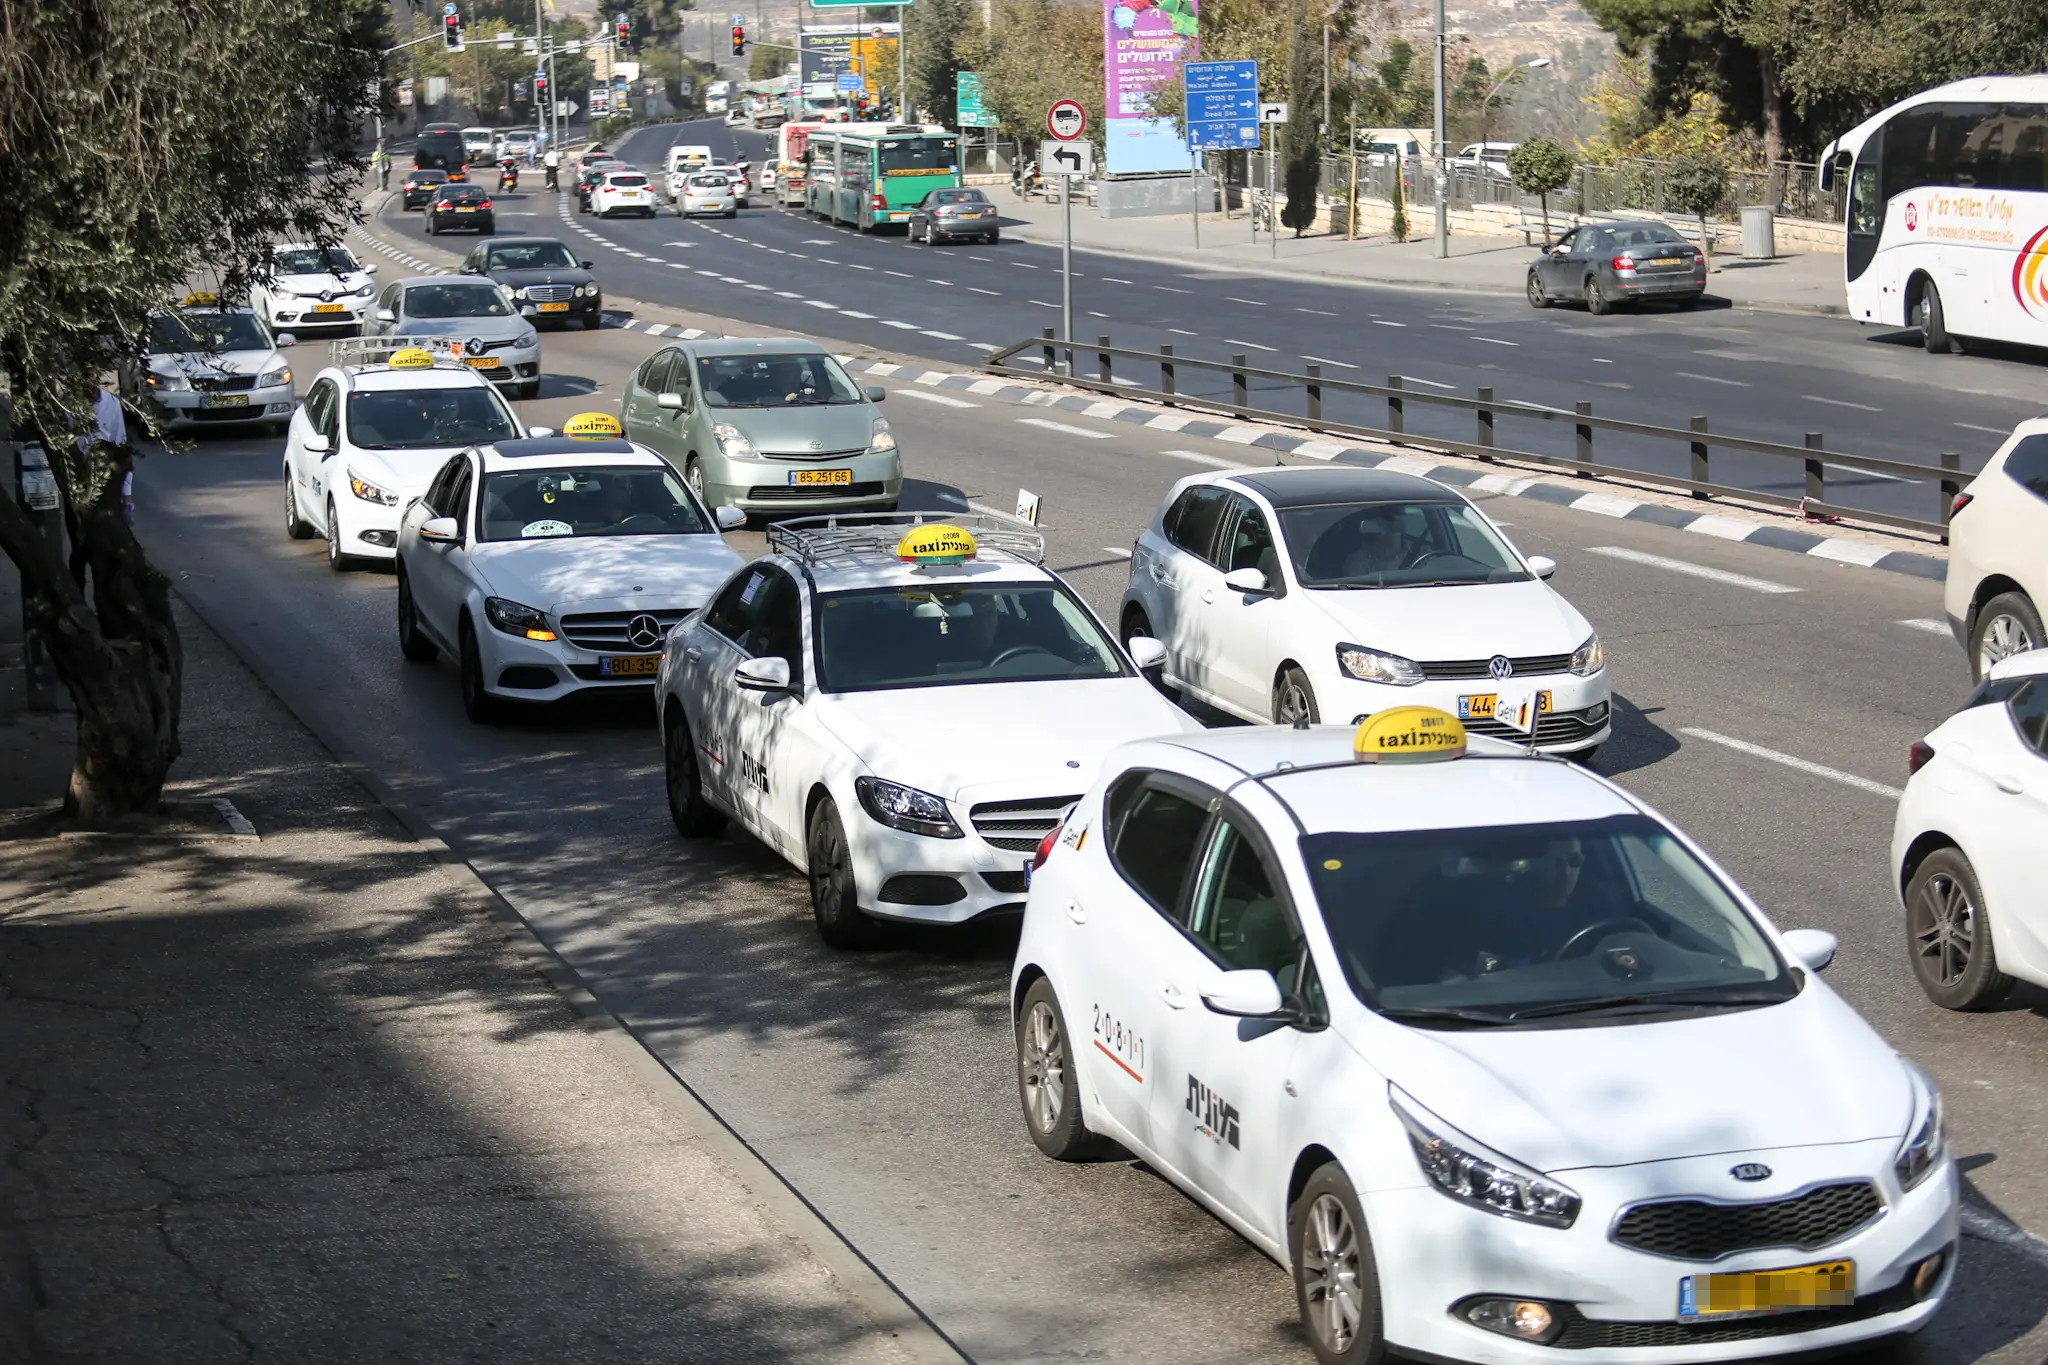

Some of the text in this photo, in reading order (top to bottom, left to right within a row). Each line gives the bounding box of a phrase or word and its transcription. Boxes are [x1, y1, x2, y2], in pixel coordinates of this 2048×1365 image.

[1117, 50, 1174, 63] בירושלים
[572, 420, 616, 431] taxi מונית
[913, 539, 970, 553] taxi מונית
[1497, 700, 1517, 723] Gett
[1378, 728, 1458, 747] taxi מונית
[1063, 827, 1079, 849] Gett
[1186, 1073, 1241, 1151] מונית
[1734, 1164, 1769, 1179] KIA
